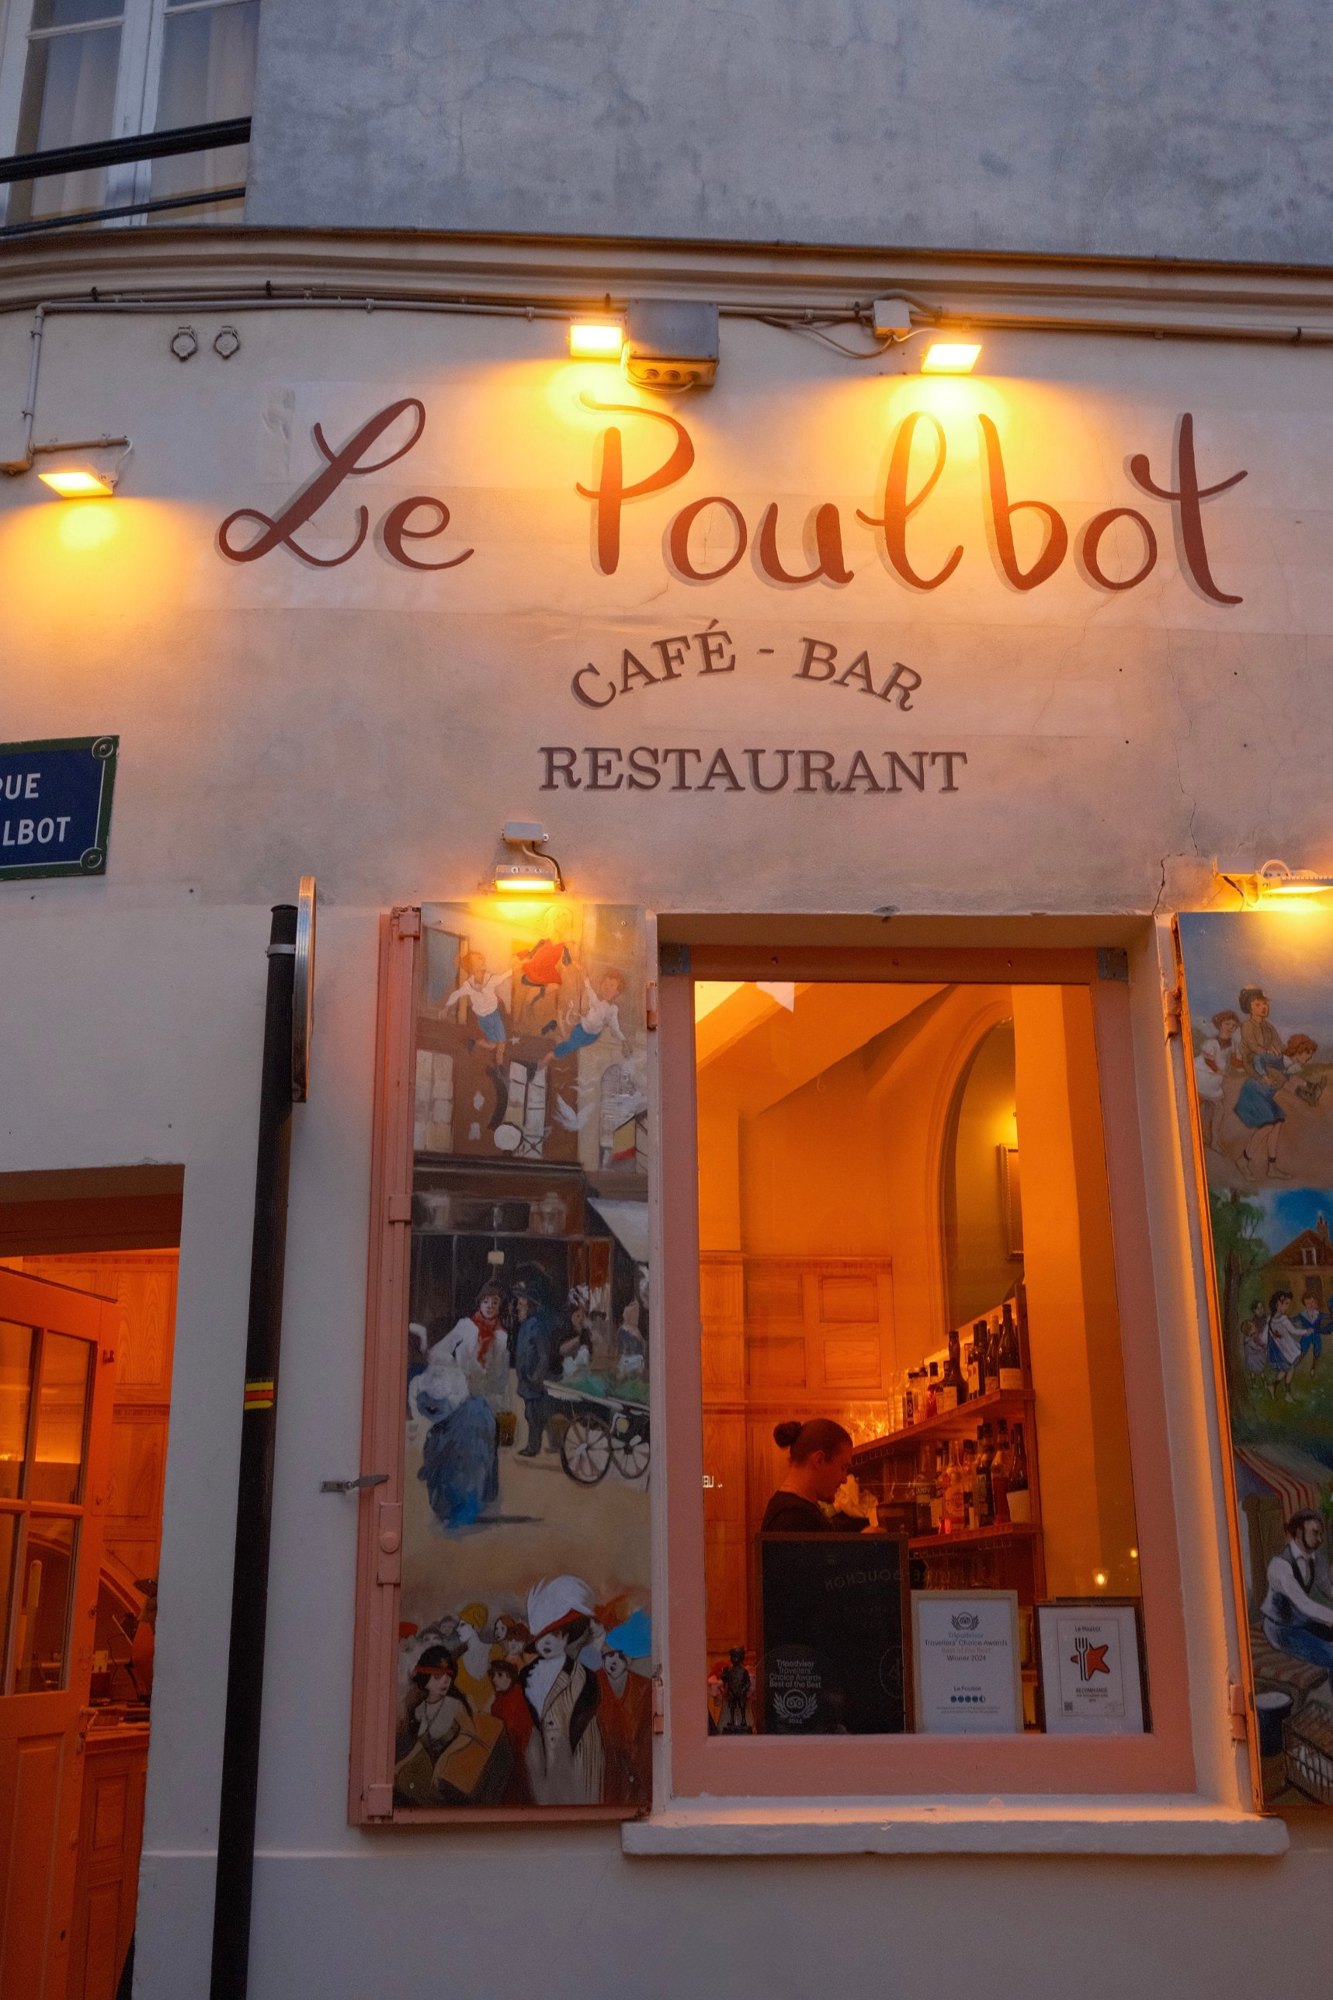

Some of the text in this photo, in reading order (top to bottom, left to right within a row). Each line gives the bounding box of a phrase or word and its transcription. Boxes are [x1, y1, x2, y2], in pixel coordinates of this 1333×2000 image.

[216, 388, 1249, 604] Le Poulbot
[571, 618, 737, 709] CAFÉ
[793, 636, 923, 712] BAR
[538, 746, 968, 794] RESTAURANT
[0, 773, 41, 801] UE
[947, 1654, 970, 1662] Winner
[769, 1673, 822, 1682] Choice Awards
[769, 1680, 785, 1688] Best
[806, 1681, 822, 1689] Best
